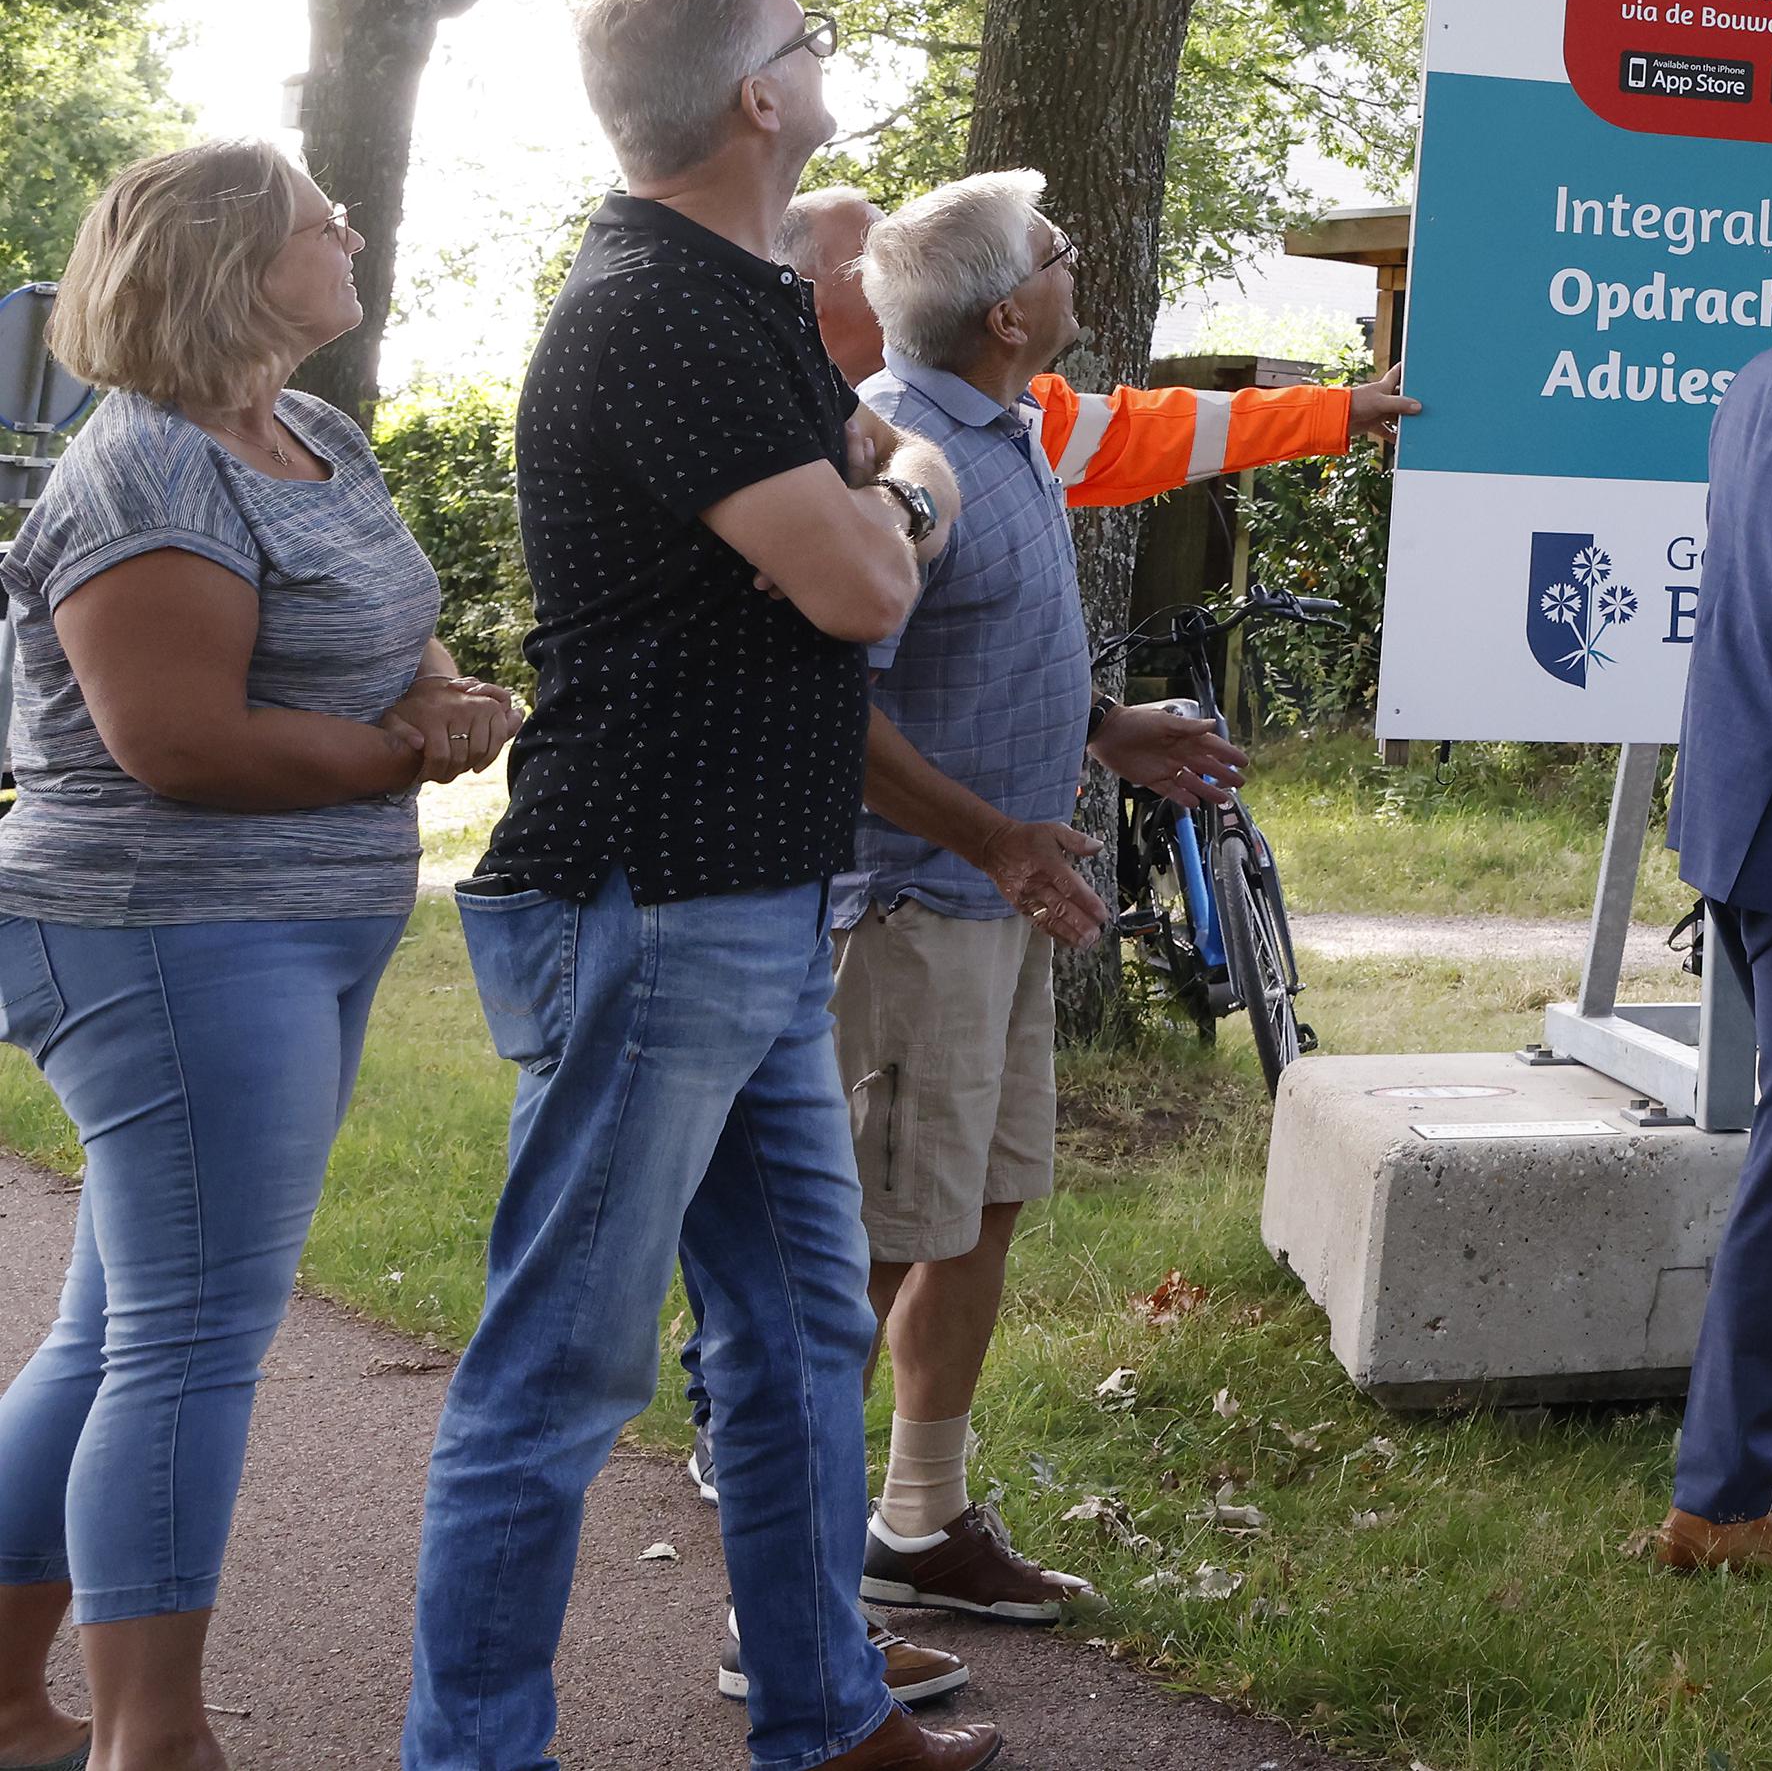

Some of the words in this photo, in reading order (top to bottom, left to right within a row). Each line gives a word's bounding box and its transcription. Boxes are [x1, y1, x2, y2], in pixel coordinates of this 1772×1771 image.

[1621, 0, 1658, 22] via
[1665, 3, 1694, 25] de
[1652, 59, 1689, 70] Available
[1691, 63, 1702, 72] on
[1703, 63, 1715, 73] the
[1717, 65, 1746, 76] iPhone
[1651, 70, 1694, 95] App
[1697, 74, 1746, 97] Store
